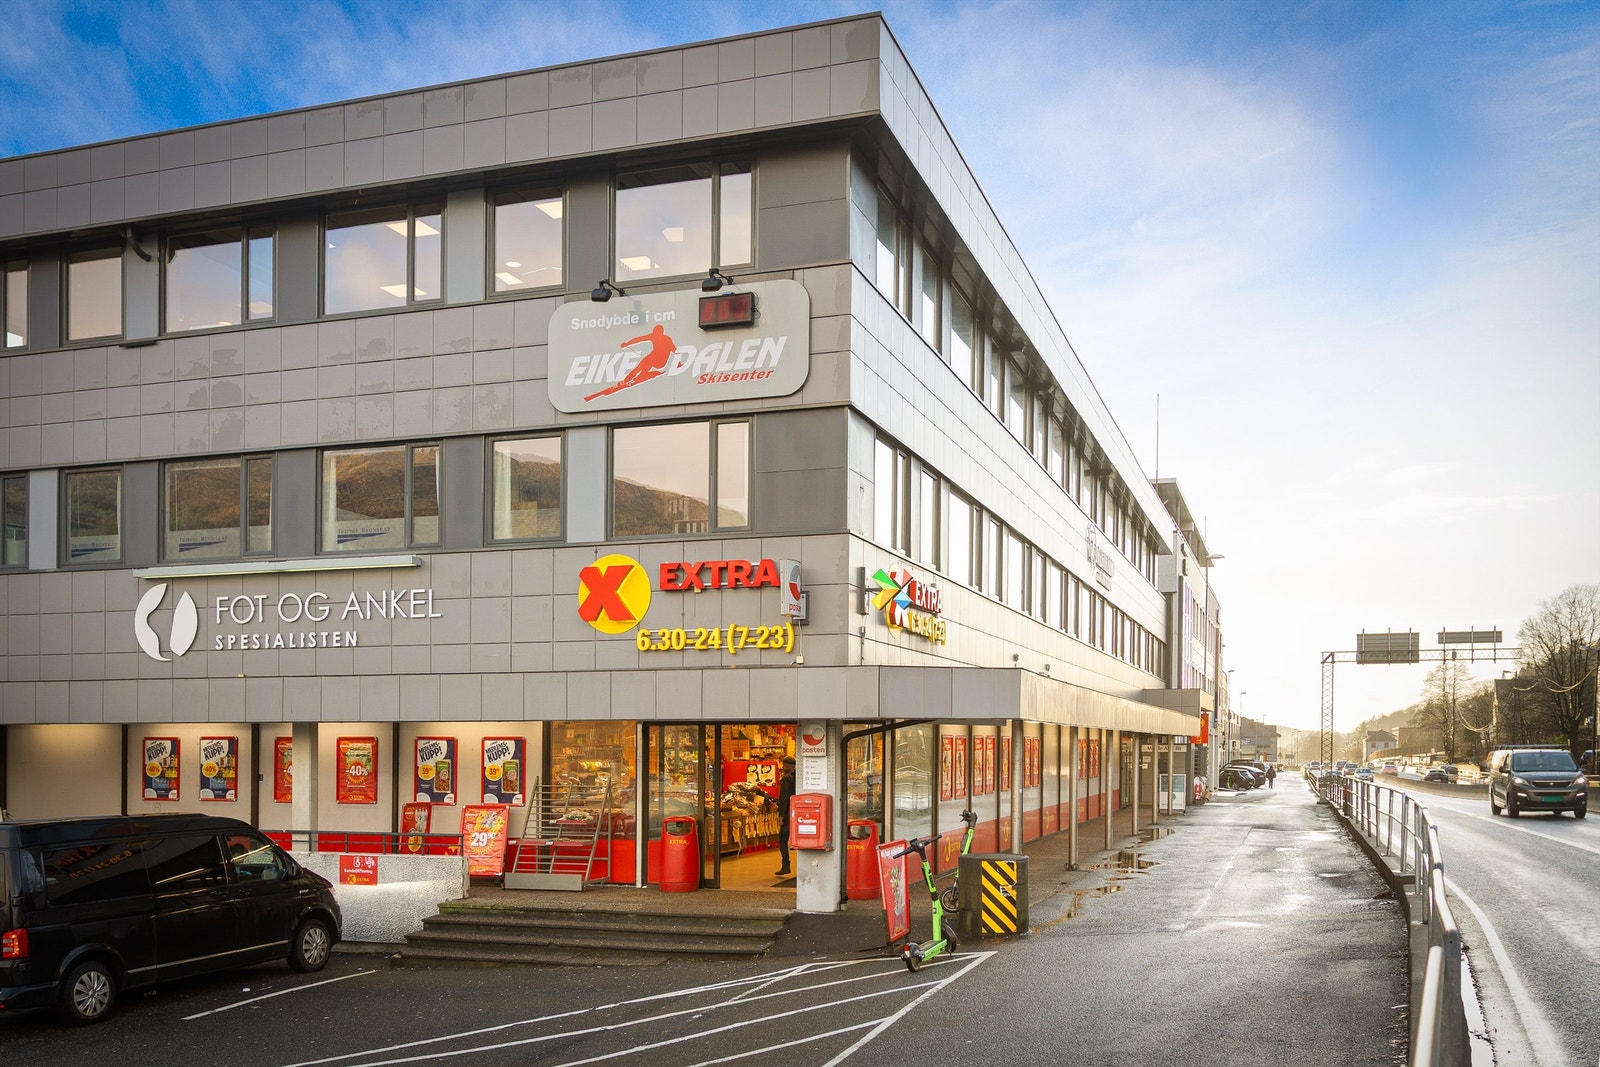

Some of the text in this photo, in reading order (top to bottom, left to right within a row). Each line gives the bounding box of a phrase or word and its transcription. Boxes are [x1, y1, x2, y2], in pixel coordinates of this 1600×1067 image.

[571, 310, 675, 330] Snødybde i cm
[697, 369, 775, 385] Skisenter
[659, 558, 781, 591] EXTRA
[215, 588, 442, 624] FOT OG ANKEL
[911, 581, 942, 613] EXTRA
[215, 631, 358, 650] SPESIALISTEN
[636, 621, 795, 654] 6.30-24 (7-23)
[147, 746, 168, 761] KUPP!
[203, 745, 225, 761] KUPP!
[420, 746, 443, 763] KUPP!
[487, 746, 511, 763] KUPP!
[345, 765, 369, 776] -40%
